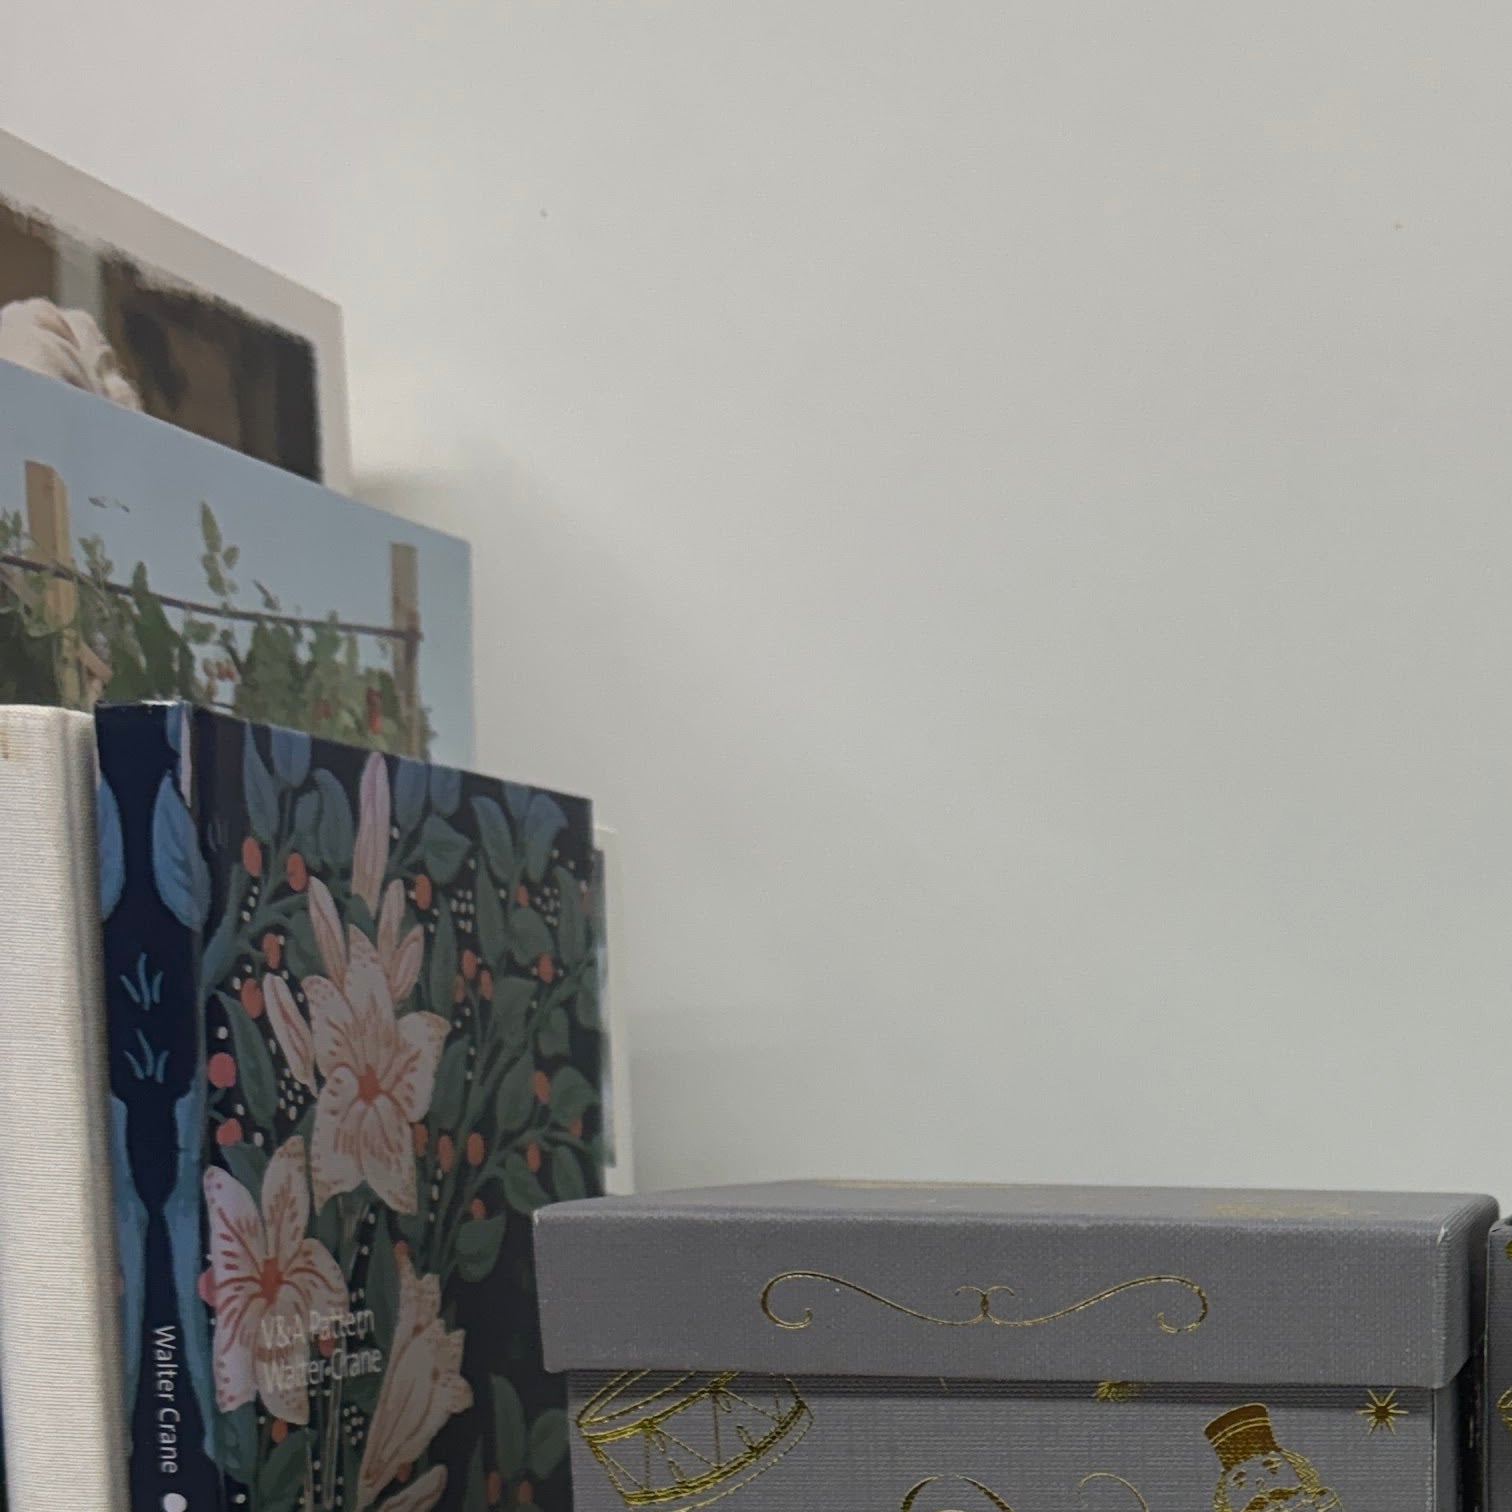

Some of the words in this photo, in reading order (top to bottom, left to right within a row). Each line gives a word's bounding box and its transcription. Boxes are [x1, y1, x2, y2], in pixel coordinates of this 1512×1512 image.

[261, 1314, 306, 1350] V&A
[309, 1308, 376, 1341] Pattern
[151, 1324, 180, 1402] Walter
[264, 1357, 326, 1394] Walter
[330, 1347, 384, 1381] Crane
[158, 1407, 181, 1475] Crane
